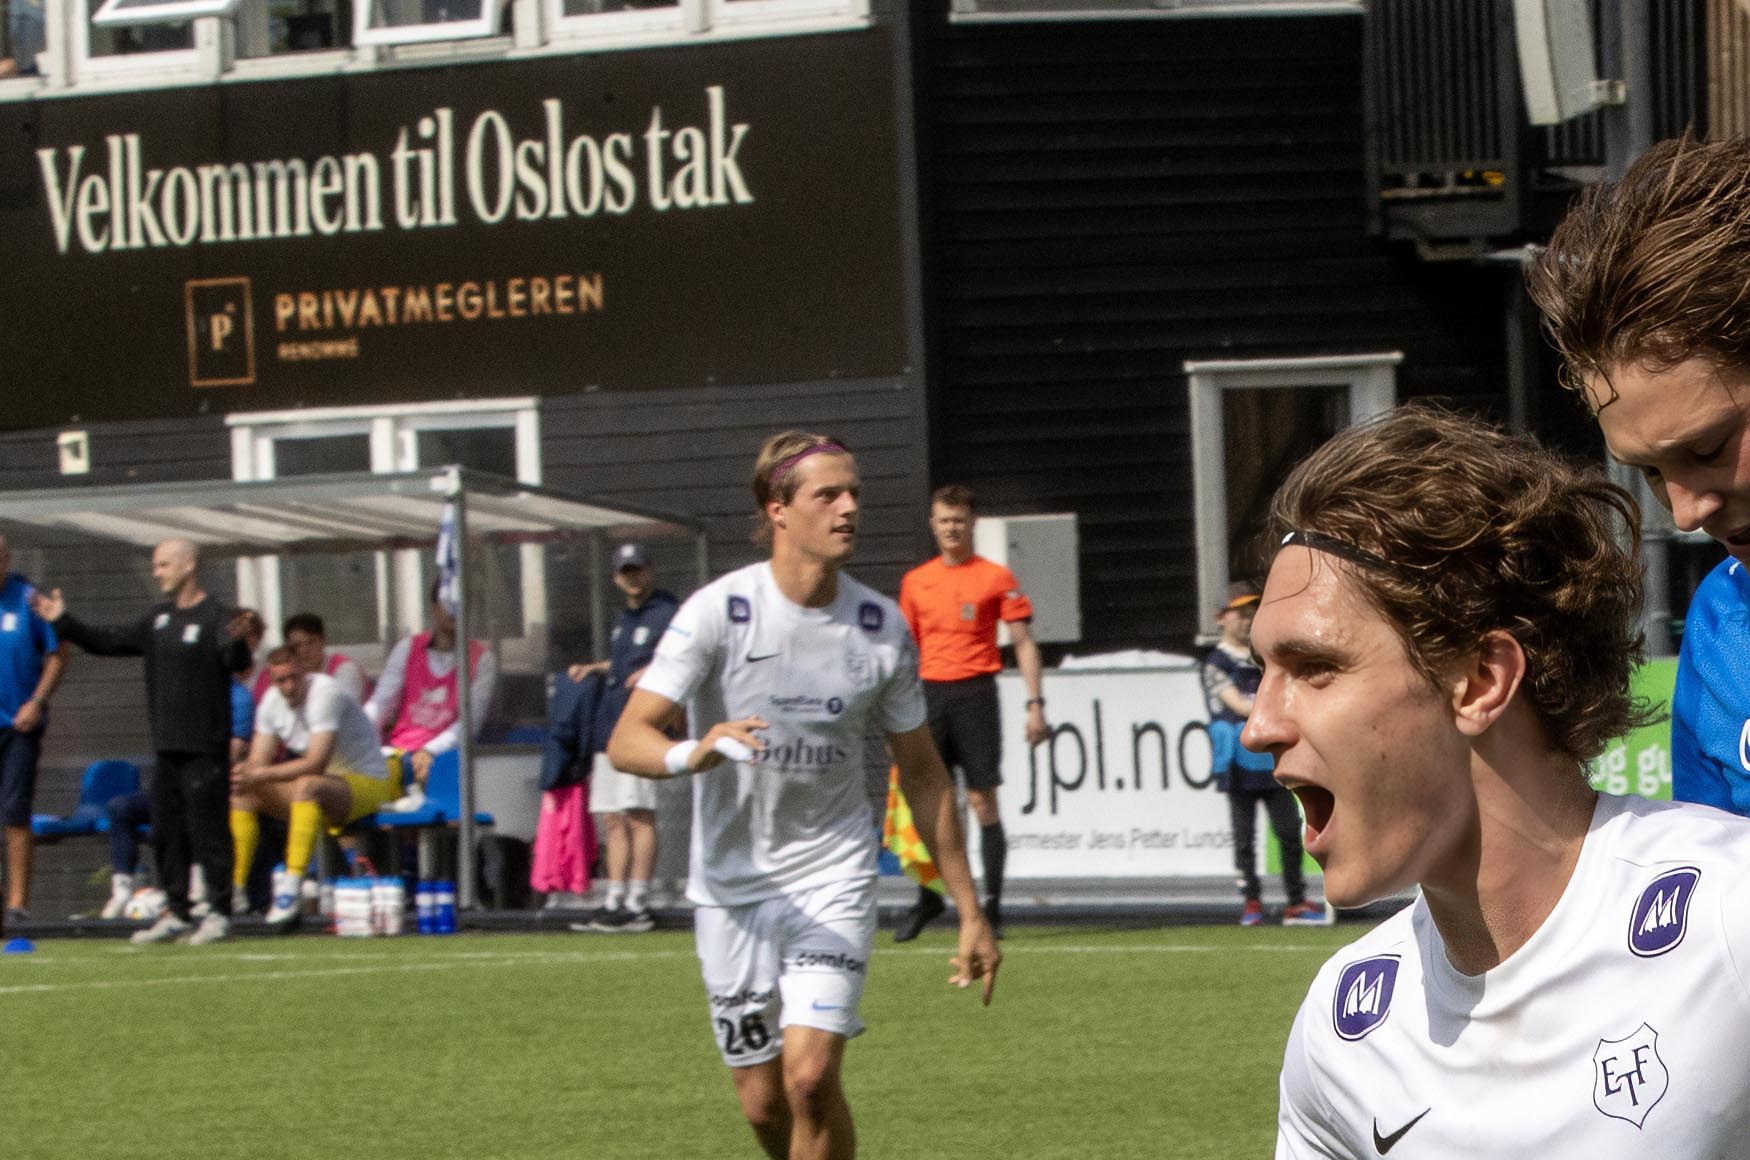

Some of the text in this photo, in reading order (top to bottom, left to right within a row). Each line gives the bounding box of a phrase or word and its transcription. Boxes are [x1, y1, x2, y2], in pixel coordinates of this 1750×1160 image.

[36, 85, 755, 254] Velkommen til Oslos tak
[274, 272, 605, 332] PRIVATMEGLEREN
[1021, 698, 1216, 815] jpl.no
